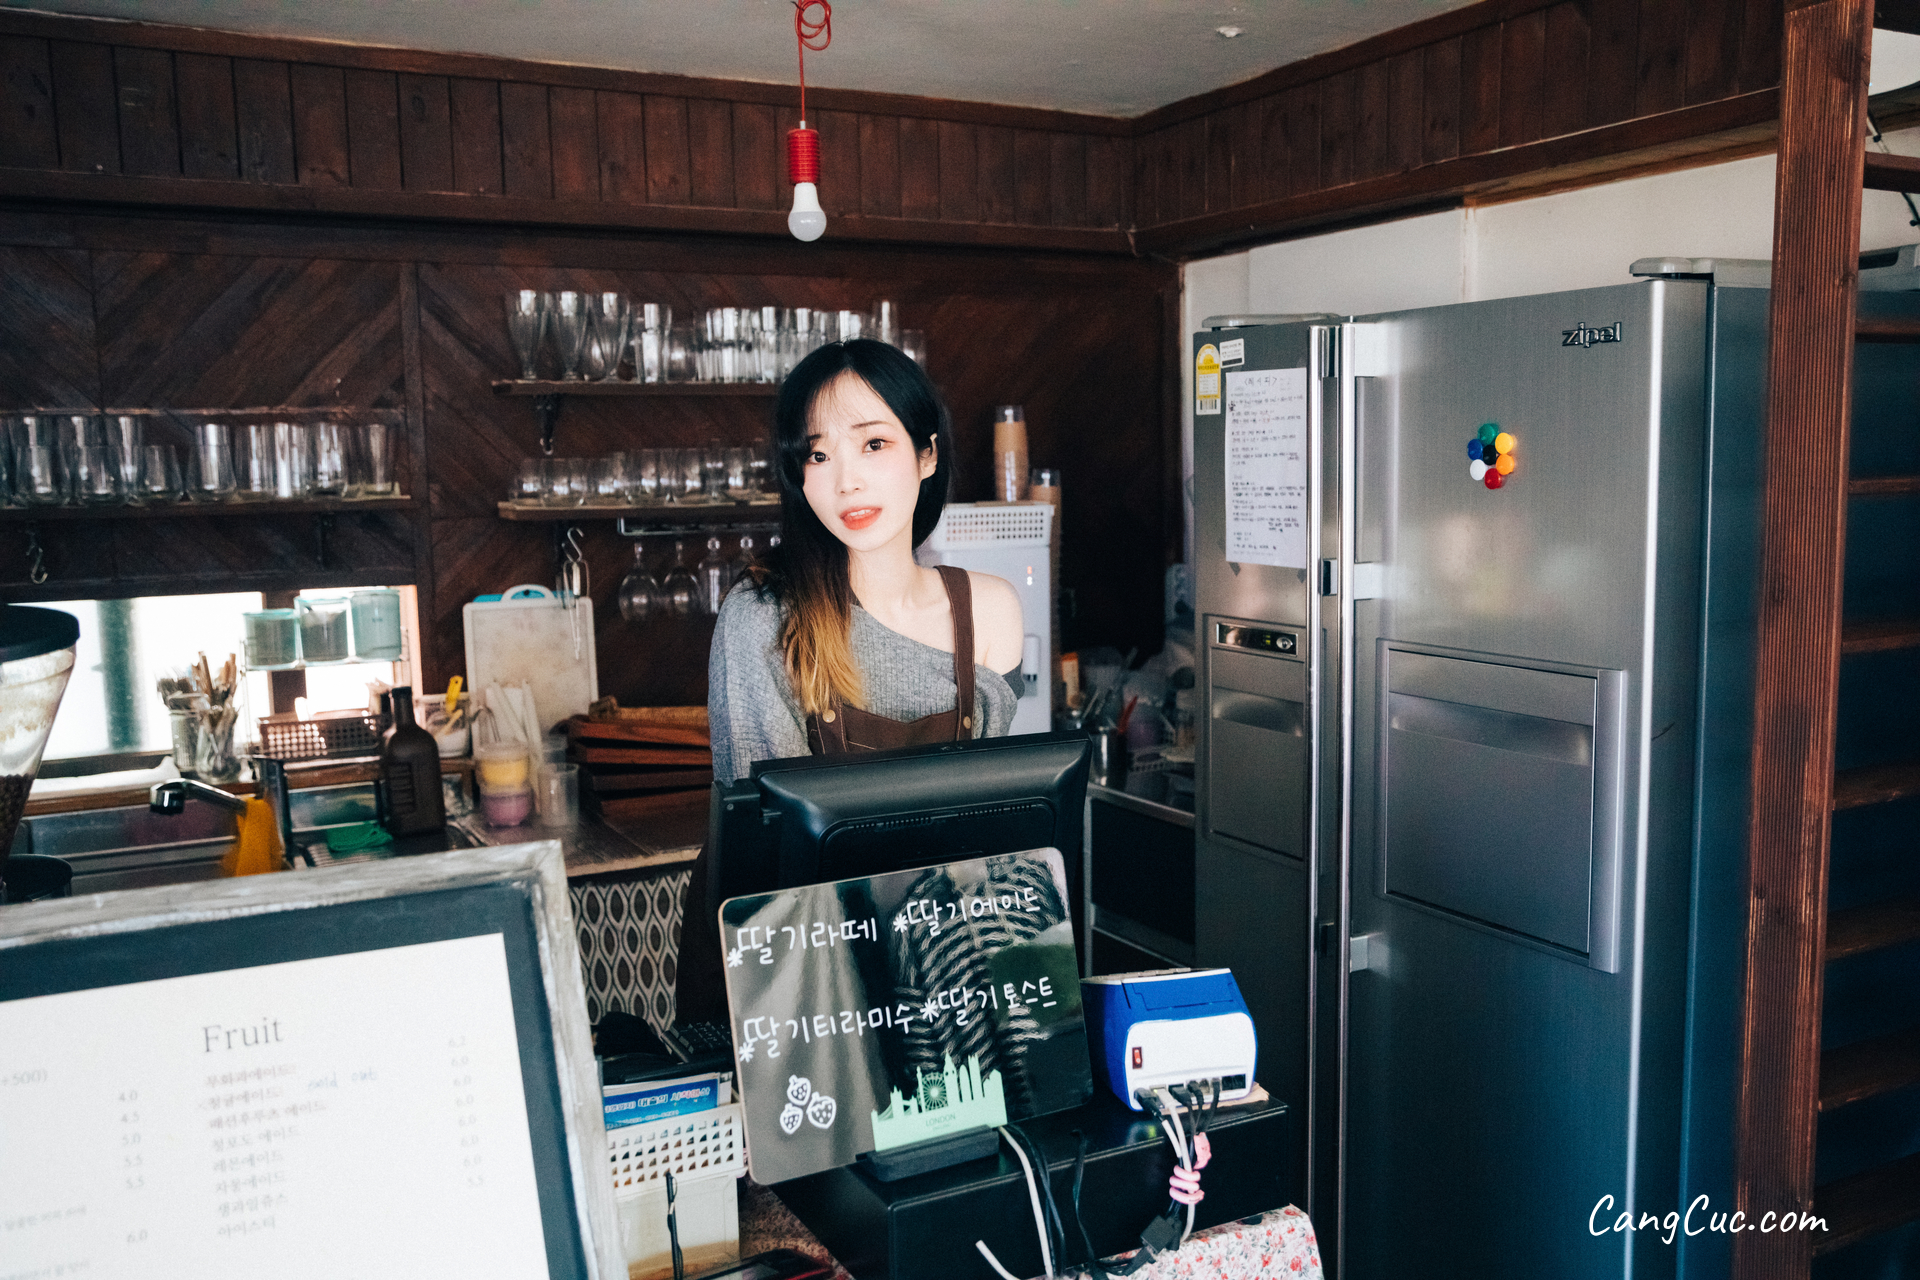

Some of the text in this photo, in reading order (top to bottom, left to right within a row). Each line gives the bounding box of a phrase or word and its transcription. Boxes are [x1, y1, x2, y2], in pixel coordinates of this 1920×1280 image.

[1562, 322, 1622, 348] zipel
[736, 887, 1041, 965] 딸기라떼 딸기에이드
[202, 1016, 284, 1053] Fruit
[743, 976, 1057, 1059] 딸기티라미수 딸기토스트
[926, 1113, 956, 1127] LONDON
